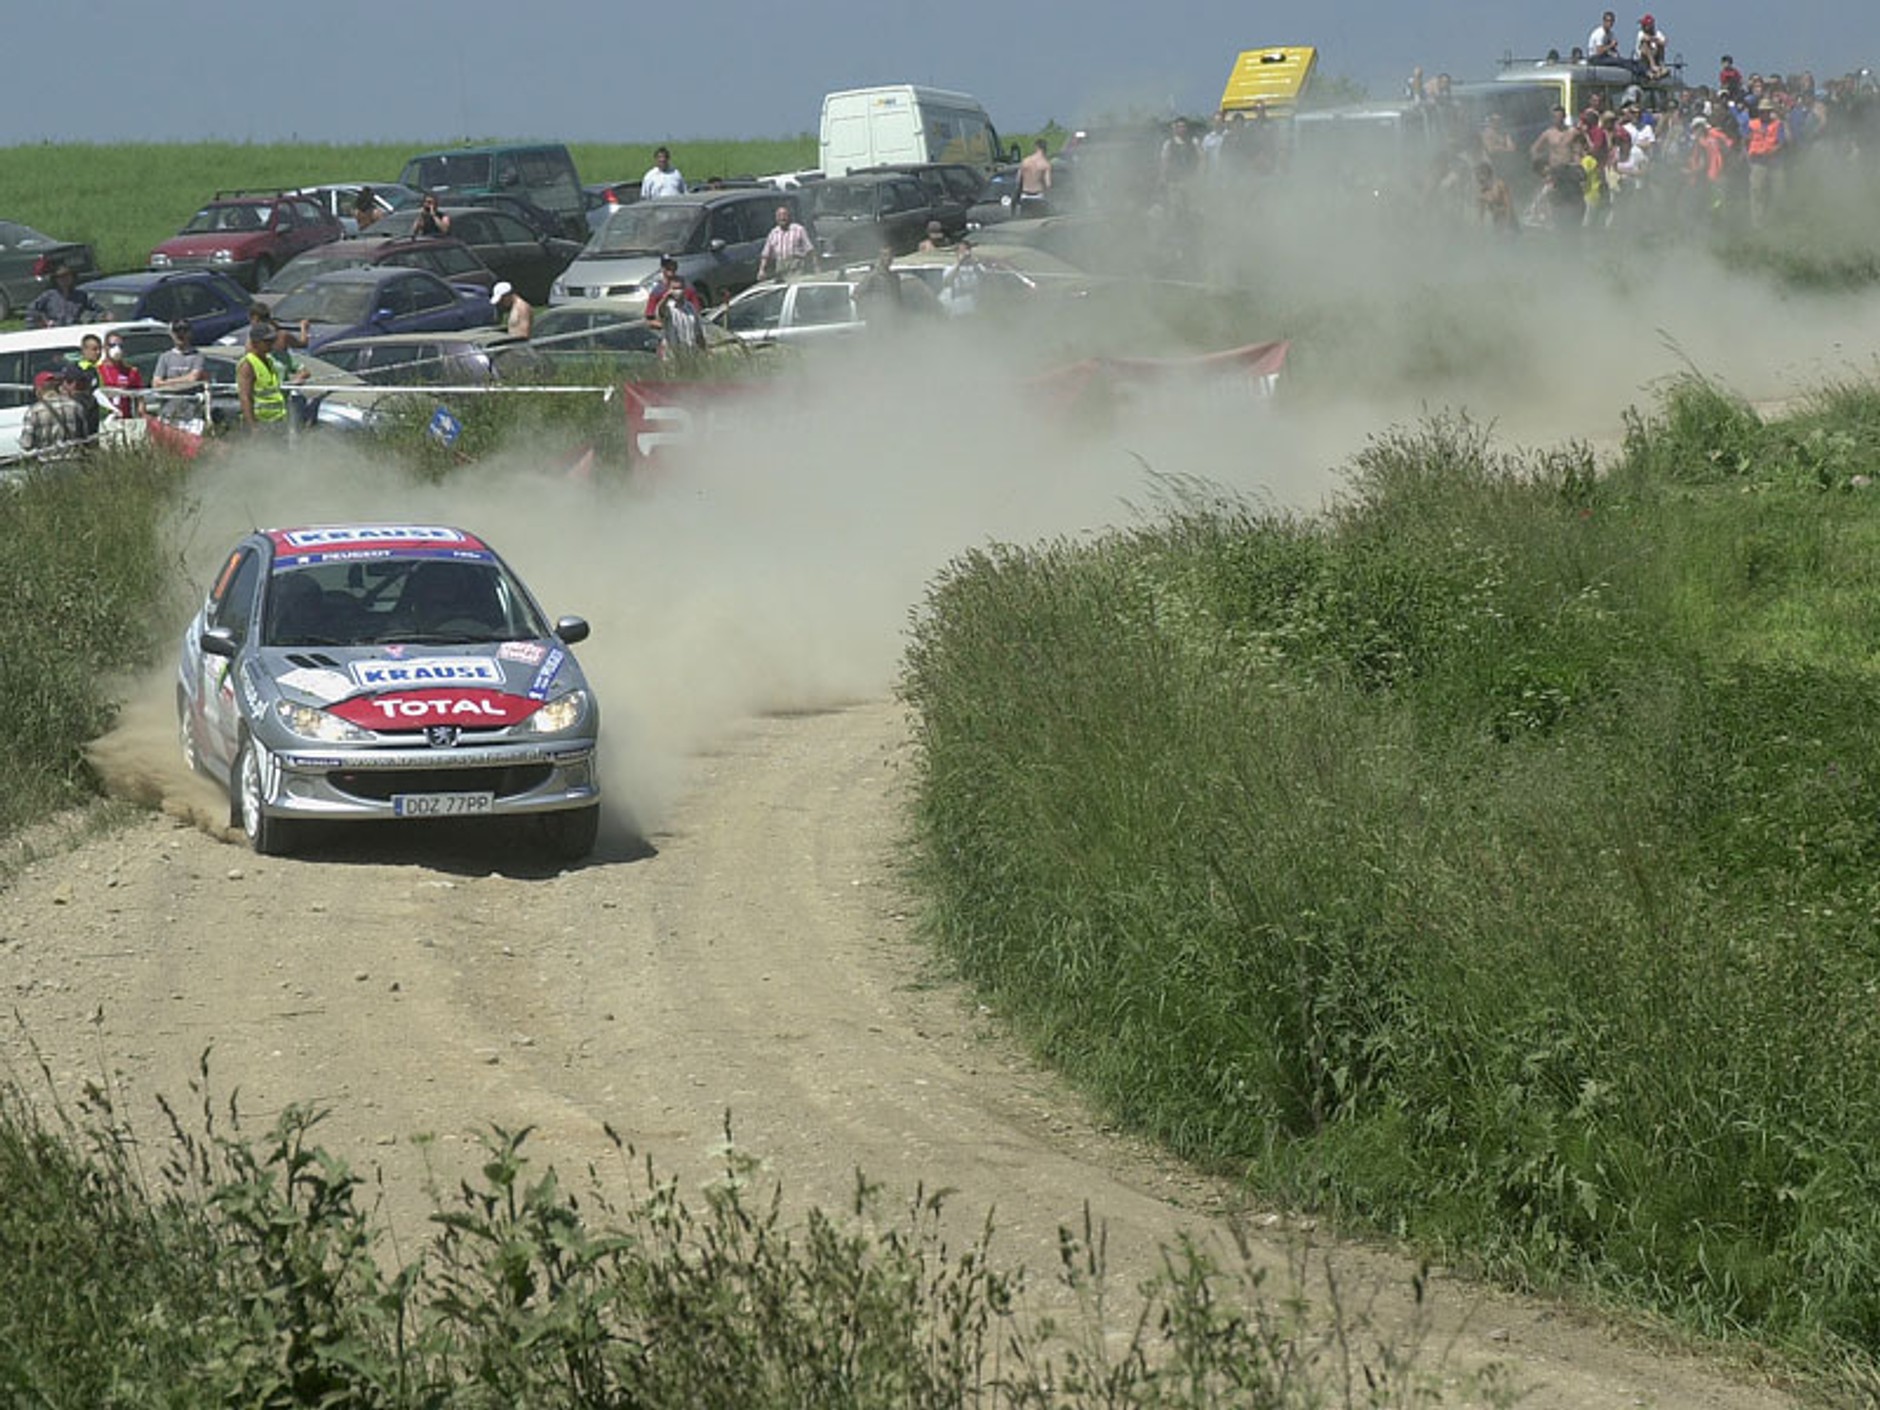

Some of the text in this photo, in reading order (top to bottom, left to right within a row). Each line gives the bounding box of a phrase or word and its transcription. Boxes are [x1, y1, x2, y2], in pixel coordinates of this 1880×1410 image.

[300, 529, 446, 542] KRAUSE
[322, 550, 391, 561] PEUGEOT
[364, 665, 493, 683] KRAUSE
[372, 699, 507, 718] TOTAL
[406, 795, 489, 815] DDZ 77PP
